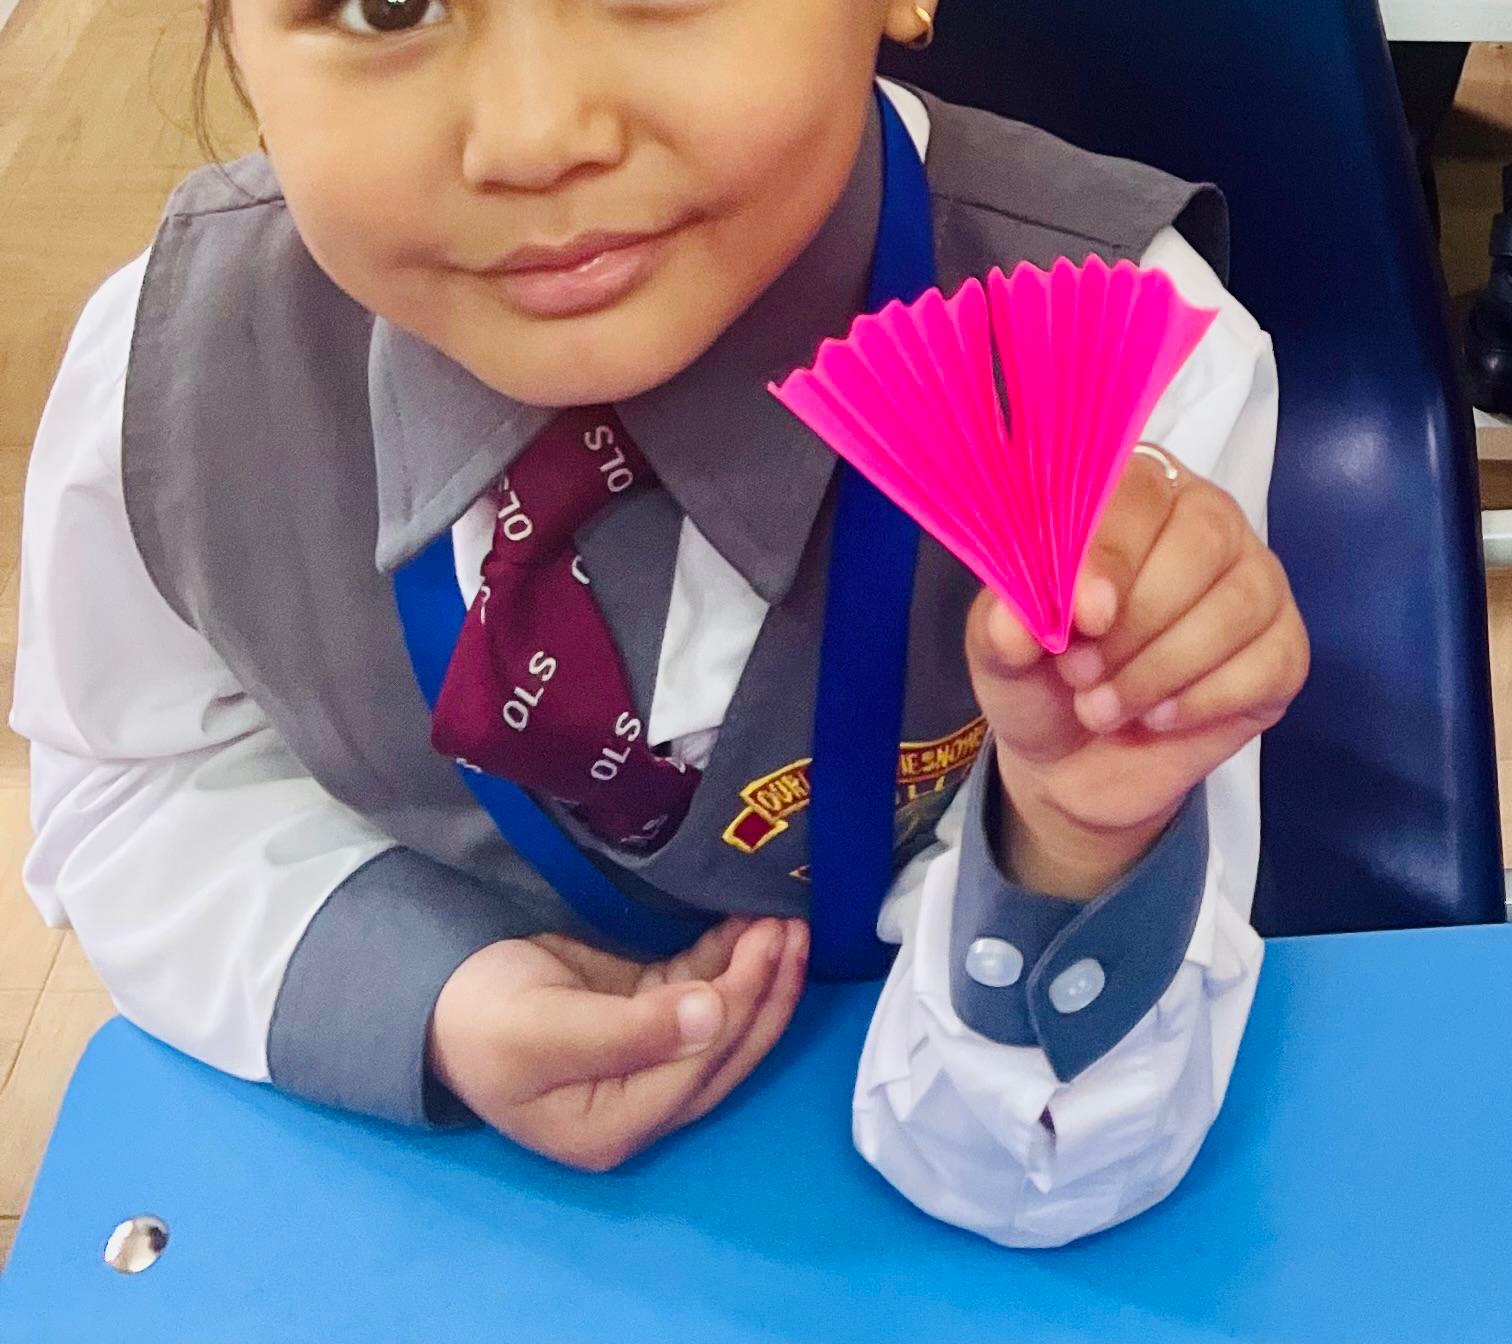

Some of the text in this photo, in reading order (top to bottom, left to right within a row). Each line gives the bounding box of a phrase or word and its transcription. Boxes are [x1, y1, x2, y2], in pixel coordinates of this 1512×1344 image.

[584, 424, 634, 494] OLS
[501, 649, 557, 732] OLS
[590, 710, 642, 783] OLS
